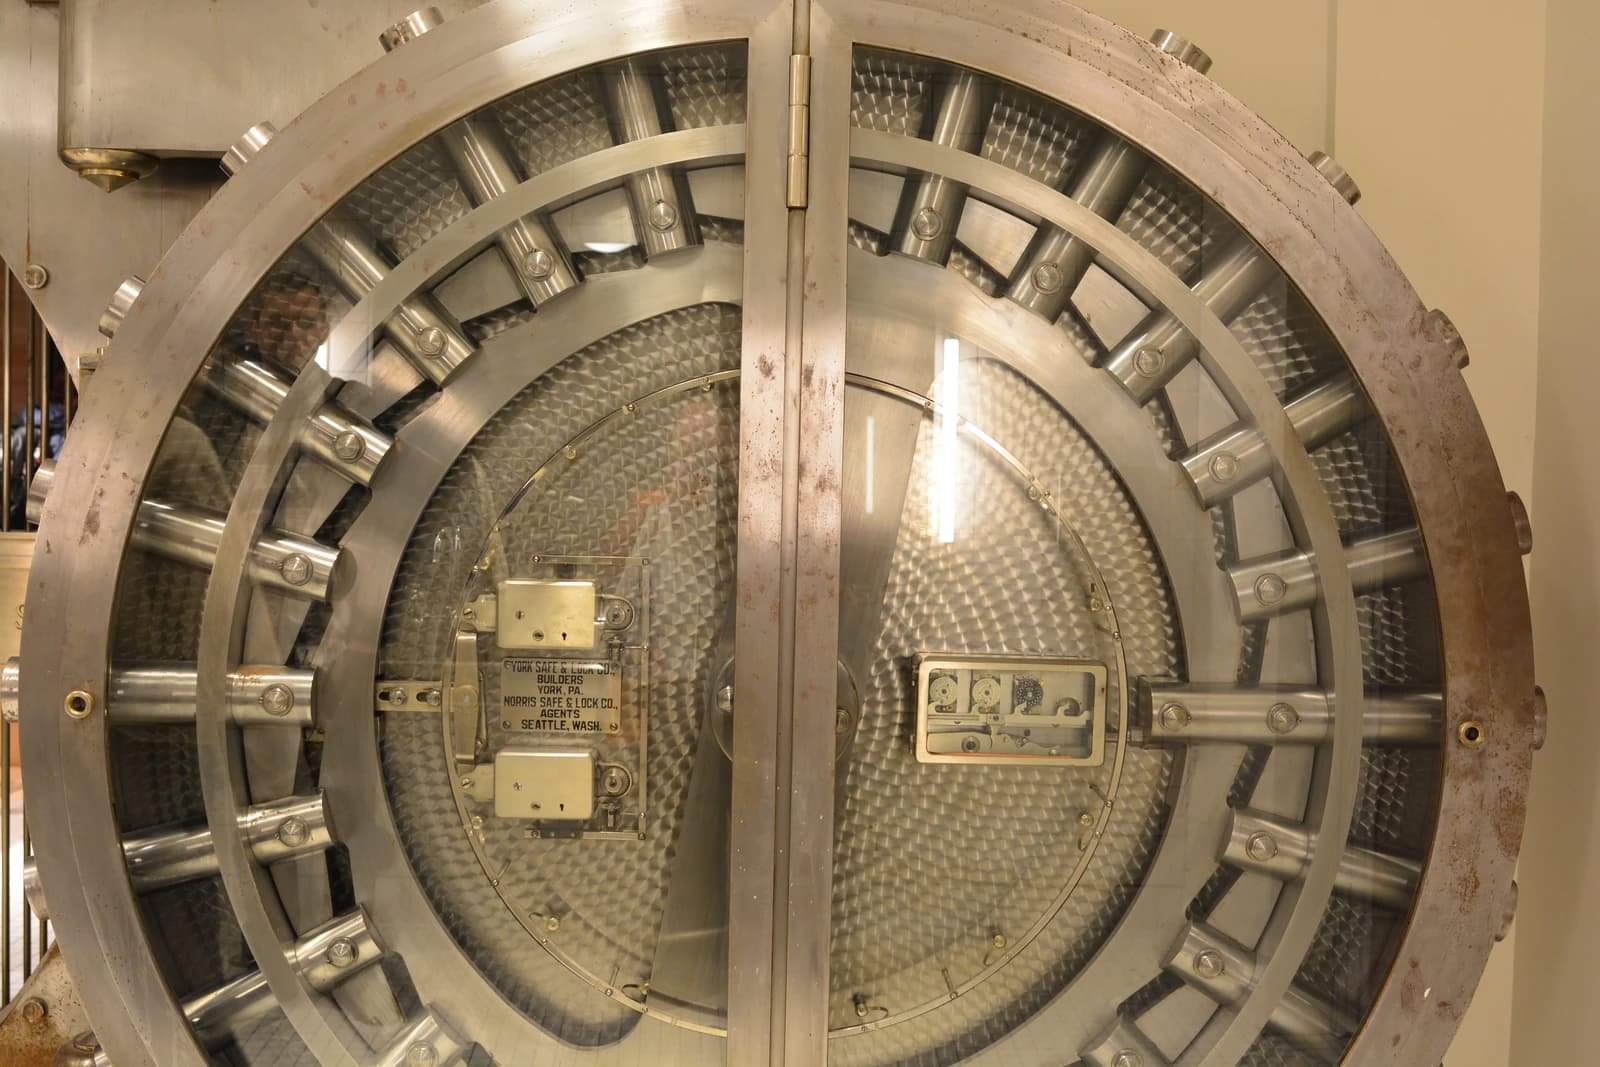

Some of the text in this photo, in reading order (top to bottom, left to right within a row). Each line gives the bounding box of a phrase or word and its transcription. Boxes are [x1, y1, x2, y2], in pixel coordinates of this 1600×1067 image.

[512, 661, 532, 672] YORK
[536, 661, 557, 673] SAFE
[561, 662, 567, 673] &
[537, 675, 583, 685] BUILDERS
[568, 686, 584, 695] PA.
[504, 696, 536, 707] NORRIS
[540, 698, 562, 708] SAFE
[567, 698, 572, 708] &
[576, 698, 598, 708] LOCK
[540, 710, 580, 718] AGENTS
[521, 720, 602, 731] SEATTLE, WASH.
